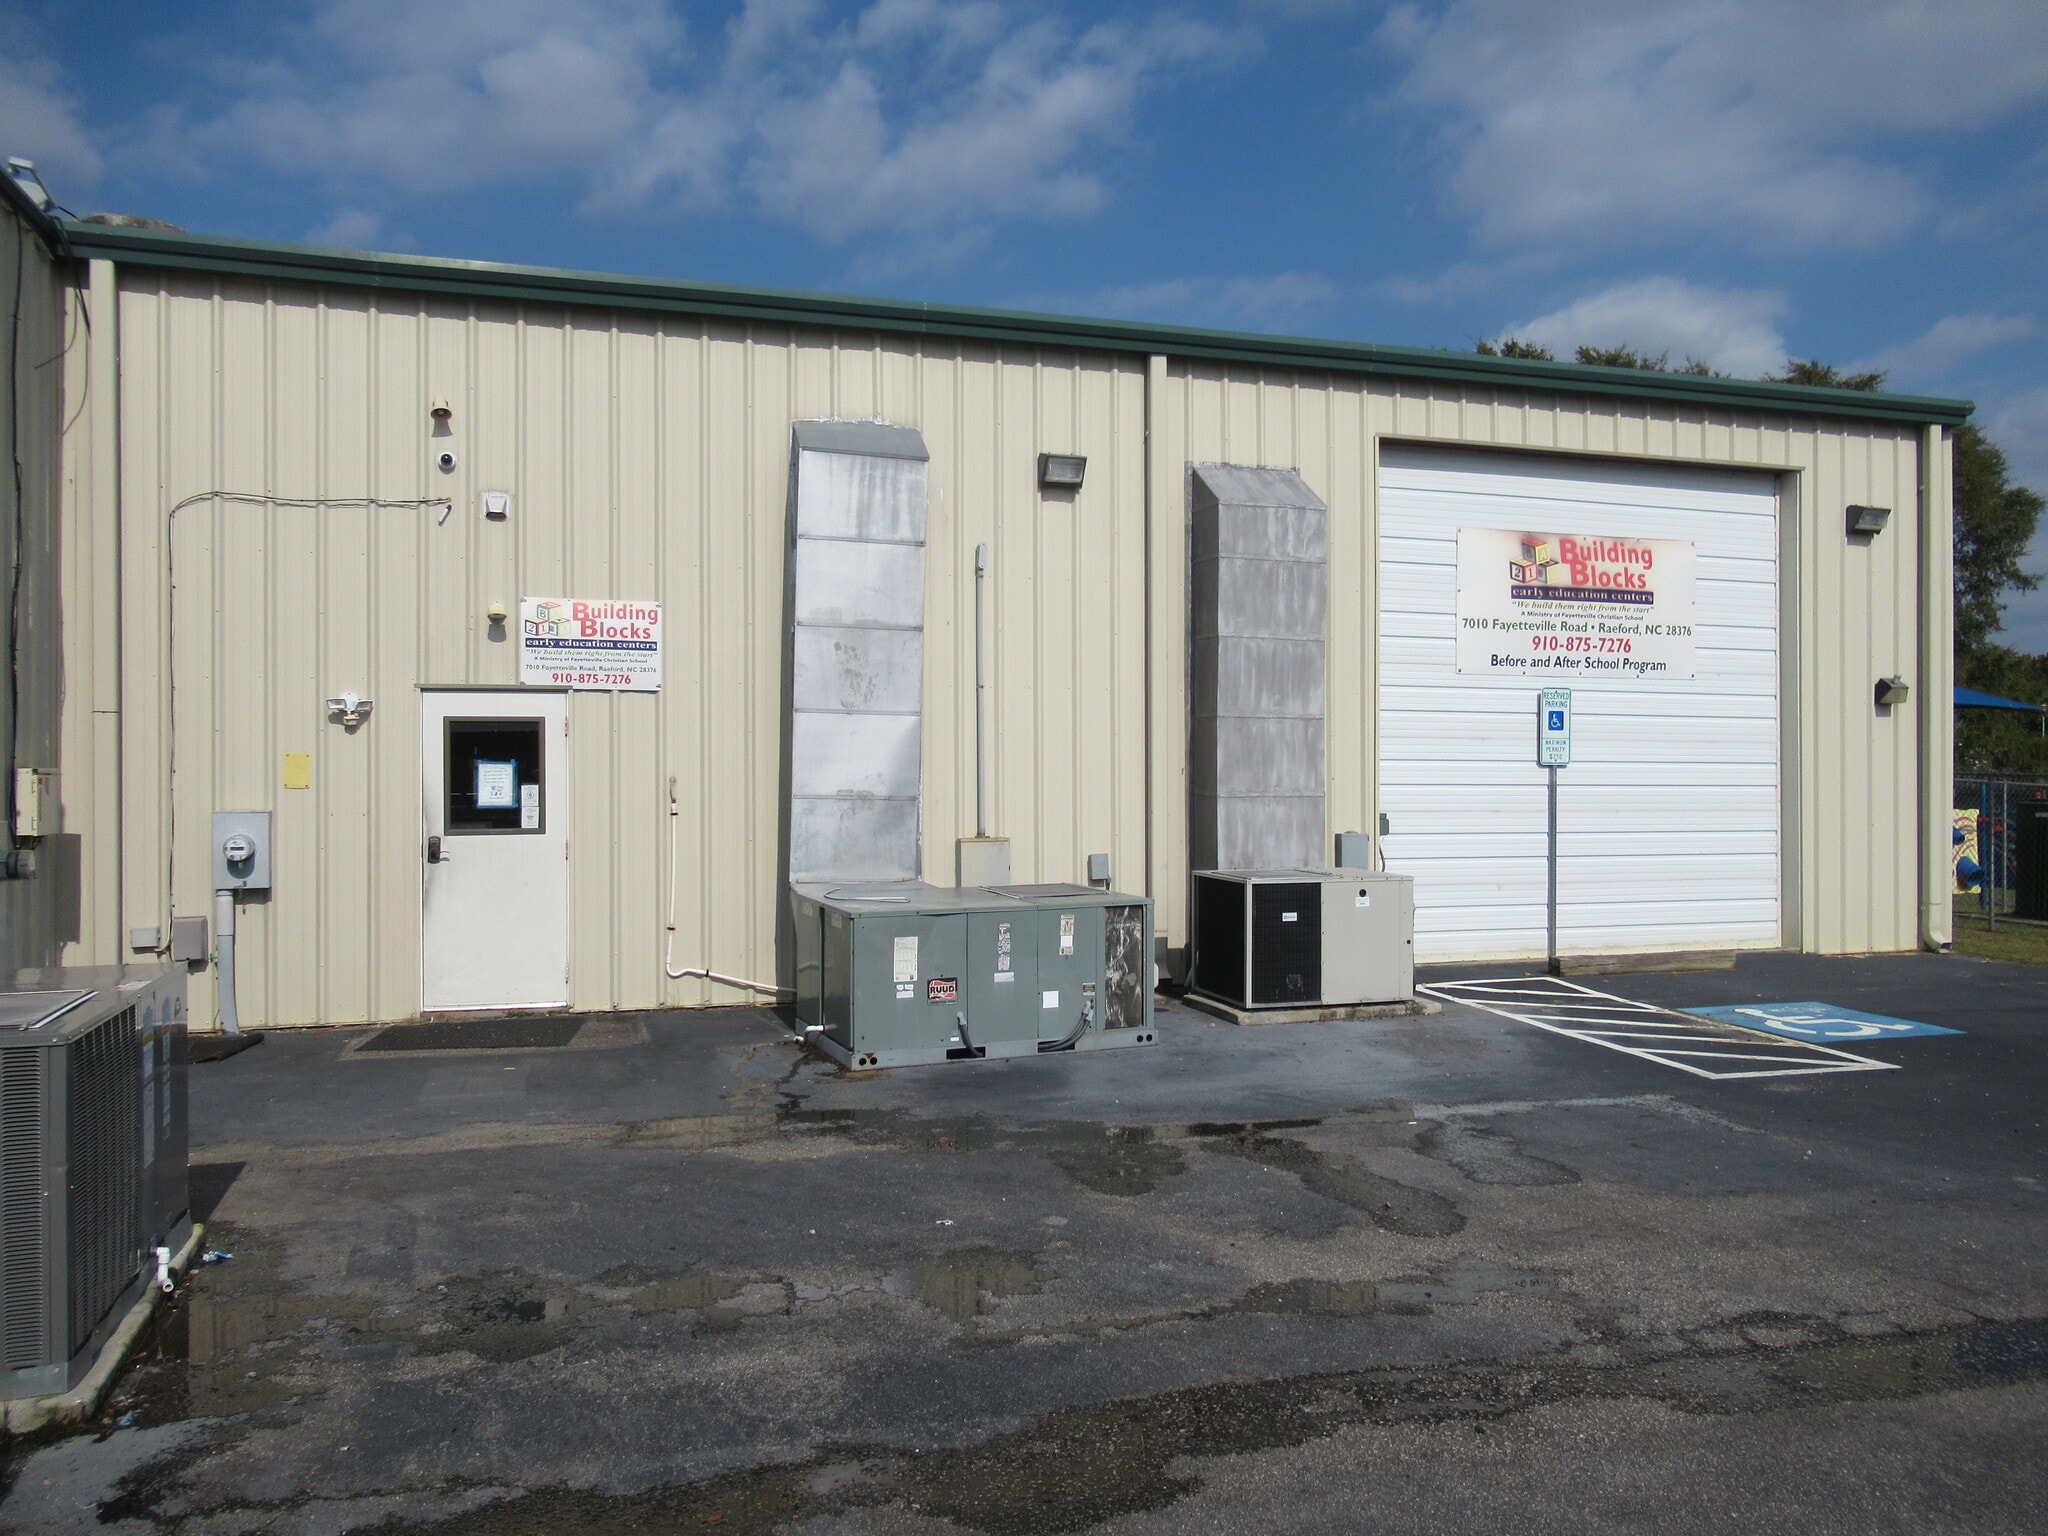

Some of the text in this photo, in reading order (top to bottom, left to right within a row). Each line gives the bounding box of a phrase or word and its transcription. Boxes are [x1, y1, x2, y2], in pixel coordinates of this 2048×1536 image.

[1559, 538, 1653, 570] Building
[1514, 567, 1521, 578] 2
[1570, 560, 1647, 589] Blocks
[1512, 587, 1653, 602] early education centers
[572, 602, 659, 625] Building
[1531, 602, 1553, 610] build
[1577, 604, 1596, 613] right
[1597, 604, 1617, 614] from
[1618, 605, 1632, 613] the
[528, 624, 535, 632] 2
[580, 618, 651, 639] Blocks
[1462, 618, 1692, 636] 7010 Fayetteville Road Raeford, NC 28376
[526, 638, 657, 649] early education centers
[1532, 635, 1632, 653] 910-875-7276
[1491, 654, 1667, 674] Before and After School Program
[552, 673, 632, 685] 910-875-7276
[1543, 692, 1569, 700] RESERVED
[930, 985, 955, 994] RUUD
